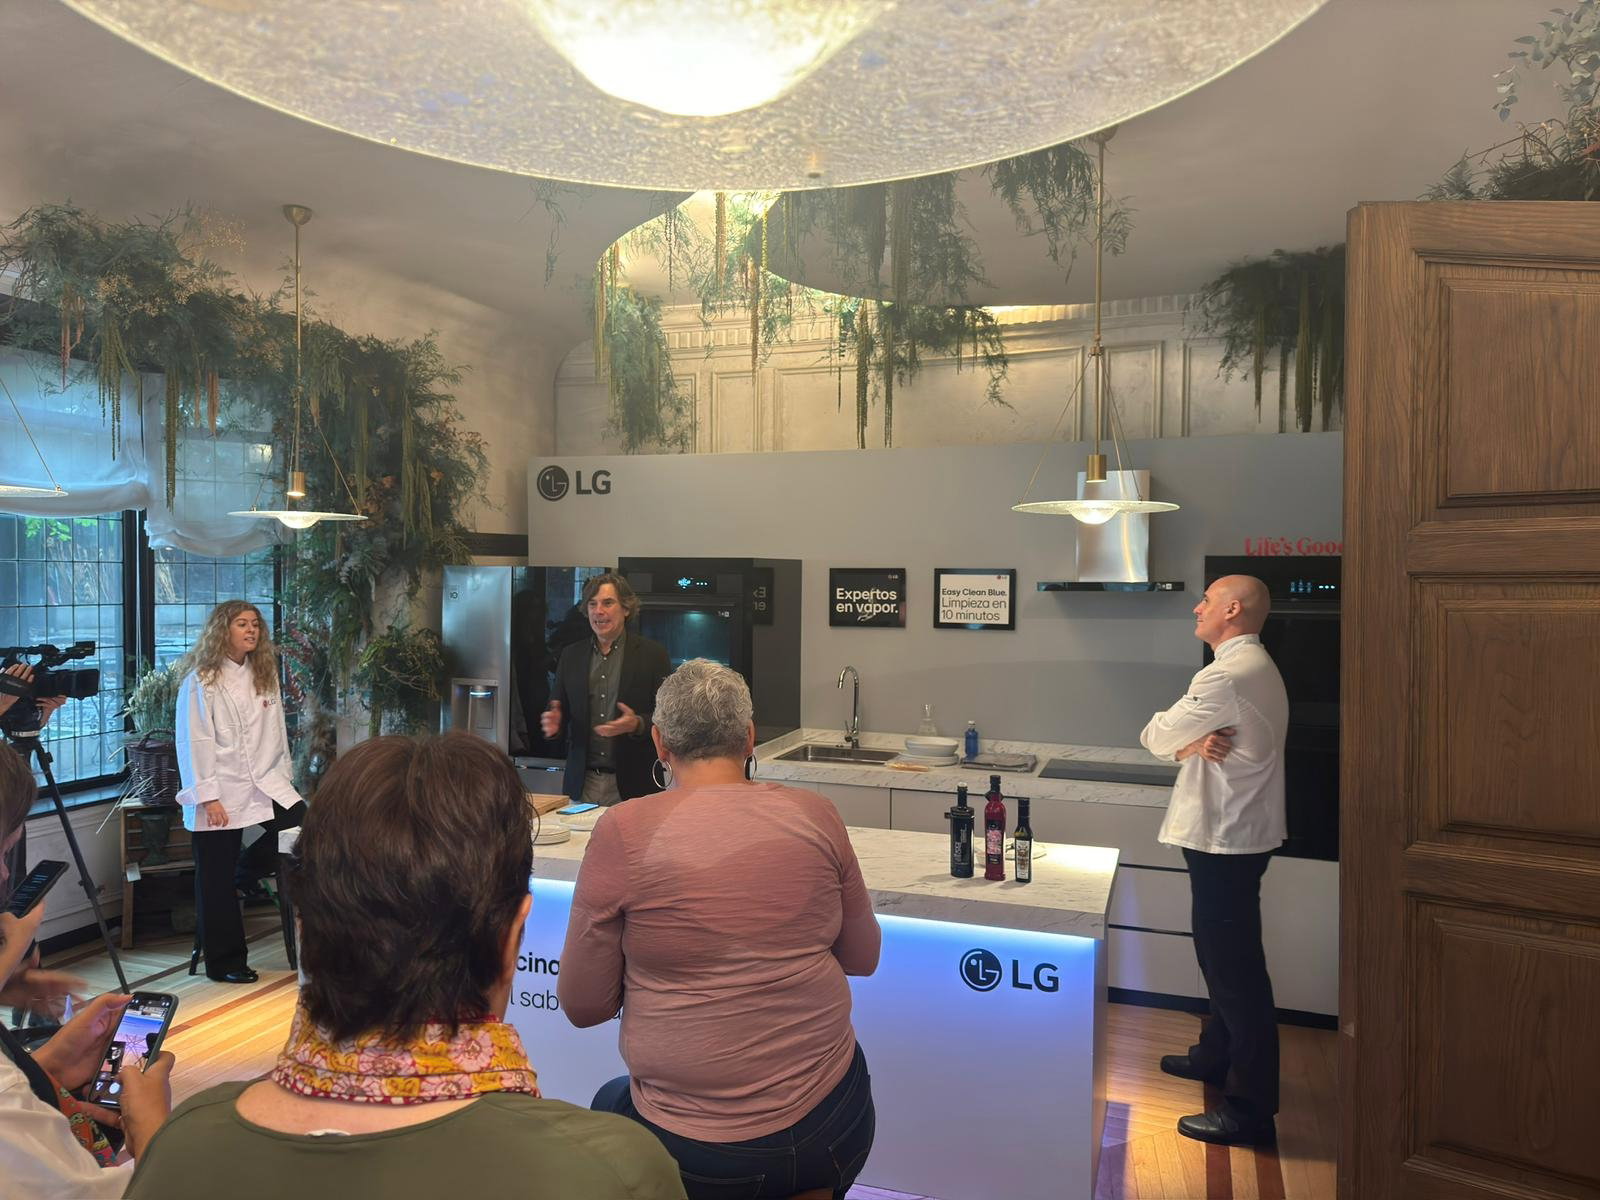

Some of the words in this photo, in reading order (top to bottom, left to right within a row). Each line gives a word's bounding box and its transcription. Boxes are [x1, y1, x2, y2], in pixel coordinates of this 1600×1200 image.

[576, 470, 611, 495] LG
[1244, 536, 1293, 556] Life's
[836, 587, 897, 602] Expertos
[942, 588, 961, 597] Easy
[962, 588, 986, 596] Clean
[988, 588, 1007, 597] Blue.
[836, 602, 853, 613] en
[856, 603, 898, 616] vapor.
[942, 597, 989, 609] Limpieza
[992, 600, 1007, 609] en
[942, 609, 954, 620] 10
[955, 610, 1000, 621] minutos
[1012, 959, 1059, 993] LG
[520, 989, 559, 1011] sab
